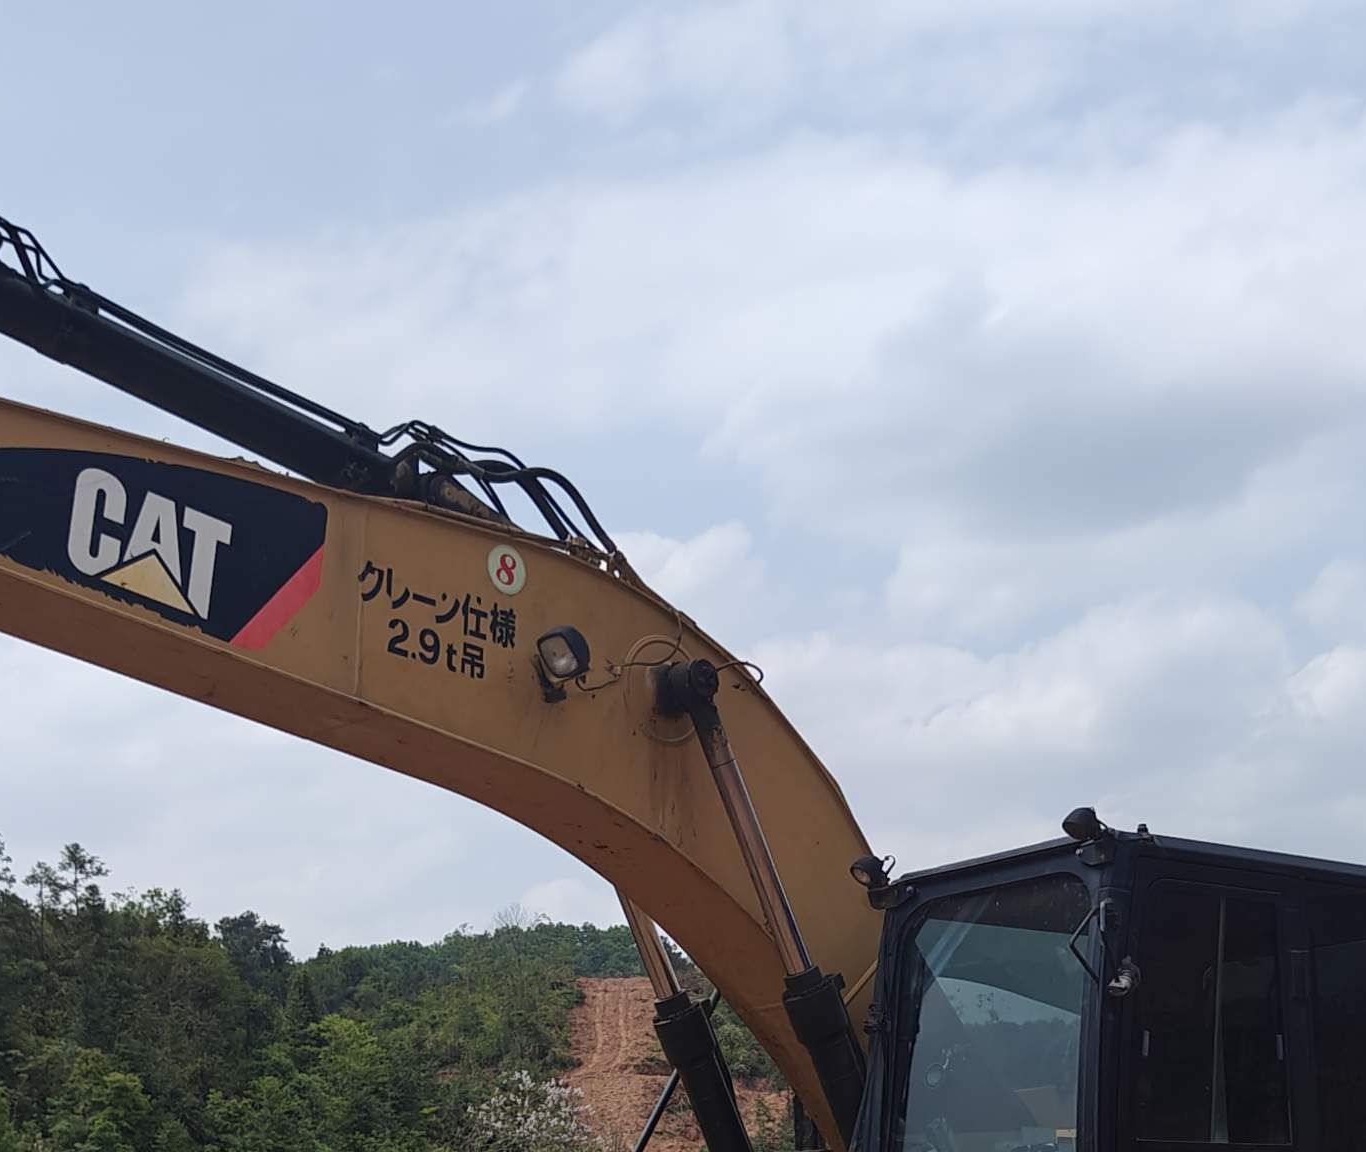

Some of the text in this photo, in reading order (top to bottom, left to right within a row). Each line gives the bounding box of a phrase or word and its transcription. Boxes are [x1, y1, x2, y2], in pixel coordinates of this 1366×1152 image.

[67, 467, 233, 621] CAT
[496, 553, 516, 586] 8
[358, 560, 516, 648] クレーン仕様
